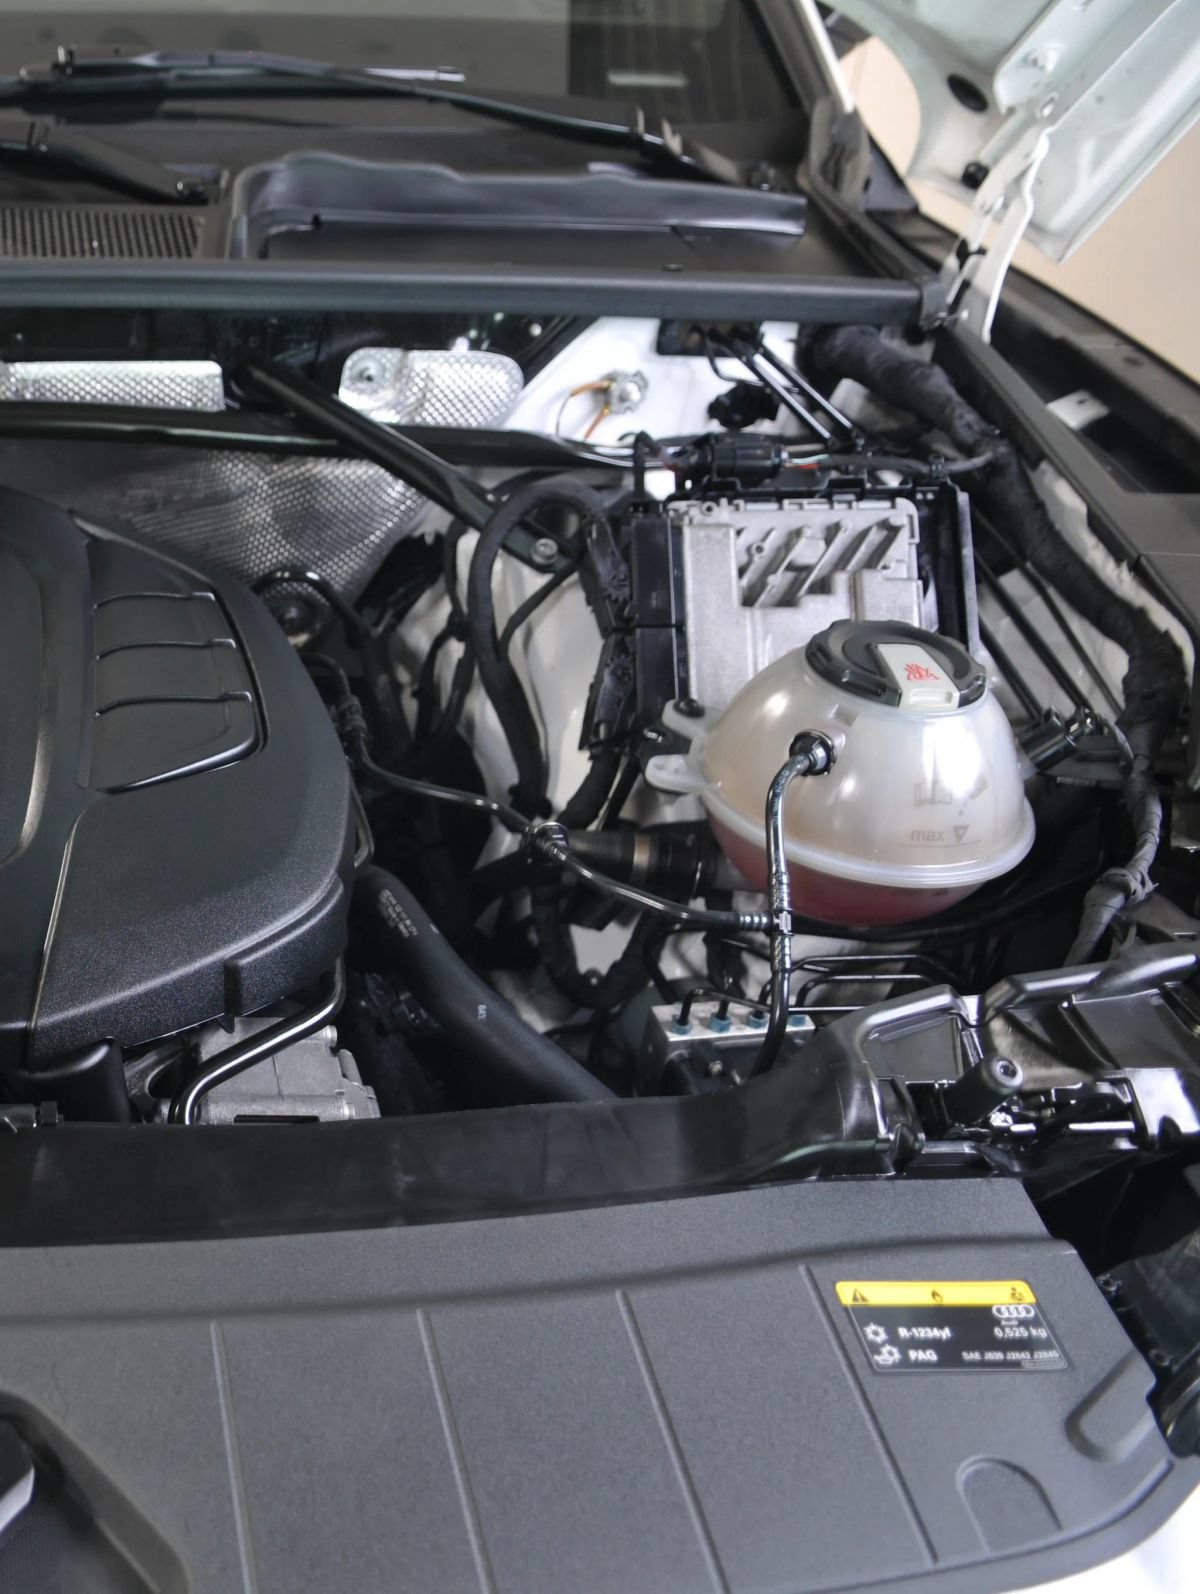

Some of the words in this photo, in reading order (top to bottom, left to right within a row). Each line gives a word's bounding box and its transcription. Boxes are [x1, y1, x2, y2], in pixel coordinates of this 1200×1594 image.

[911, 830, 945, 841] max
[897, 1325, 951, 1341] R-1234yf
[993, 1326, 1029, 1339] 0,525
[1029, 1326, 1048, 1339] kg
[908, 1348, 939, 1363] PAG
[961, 1350, 982, 1361] SAE
